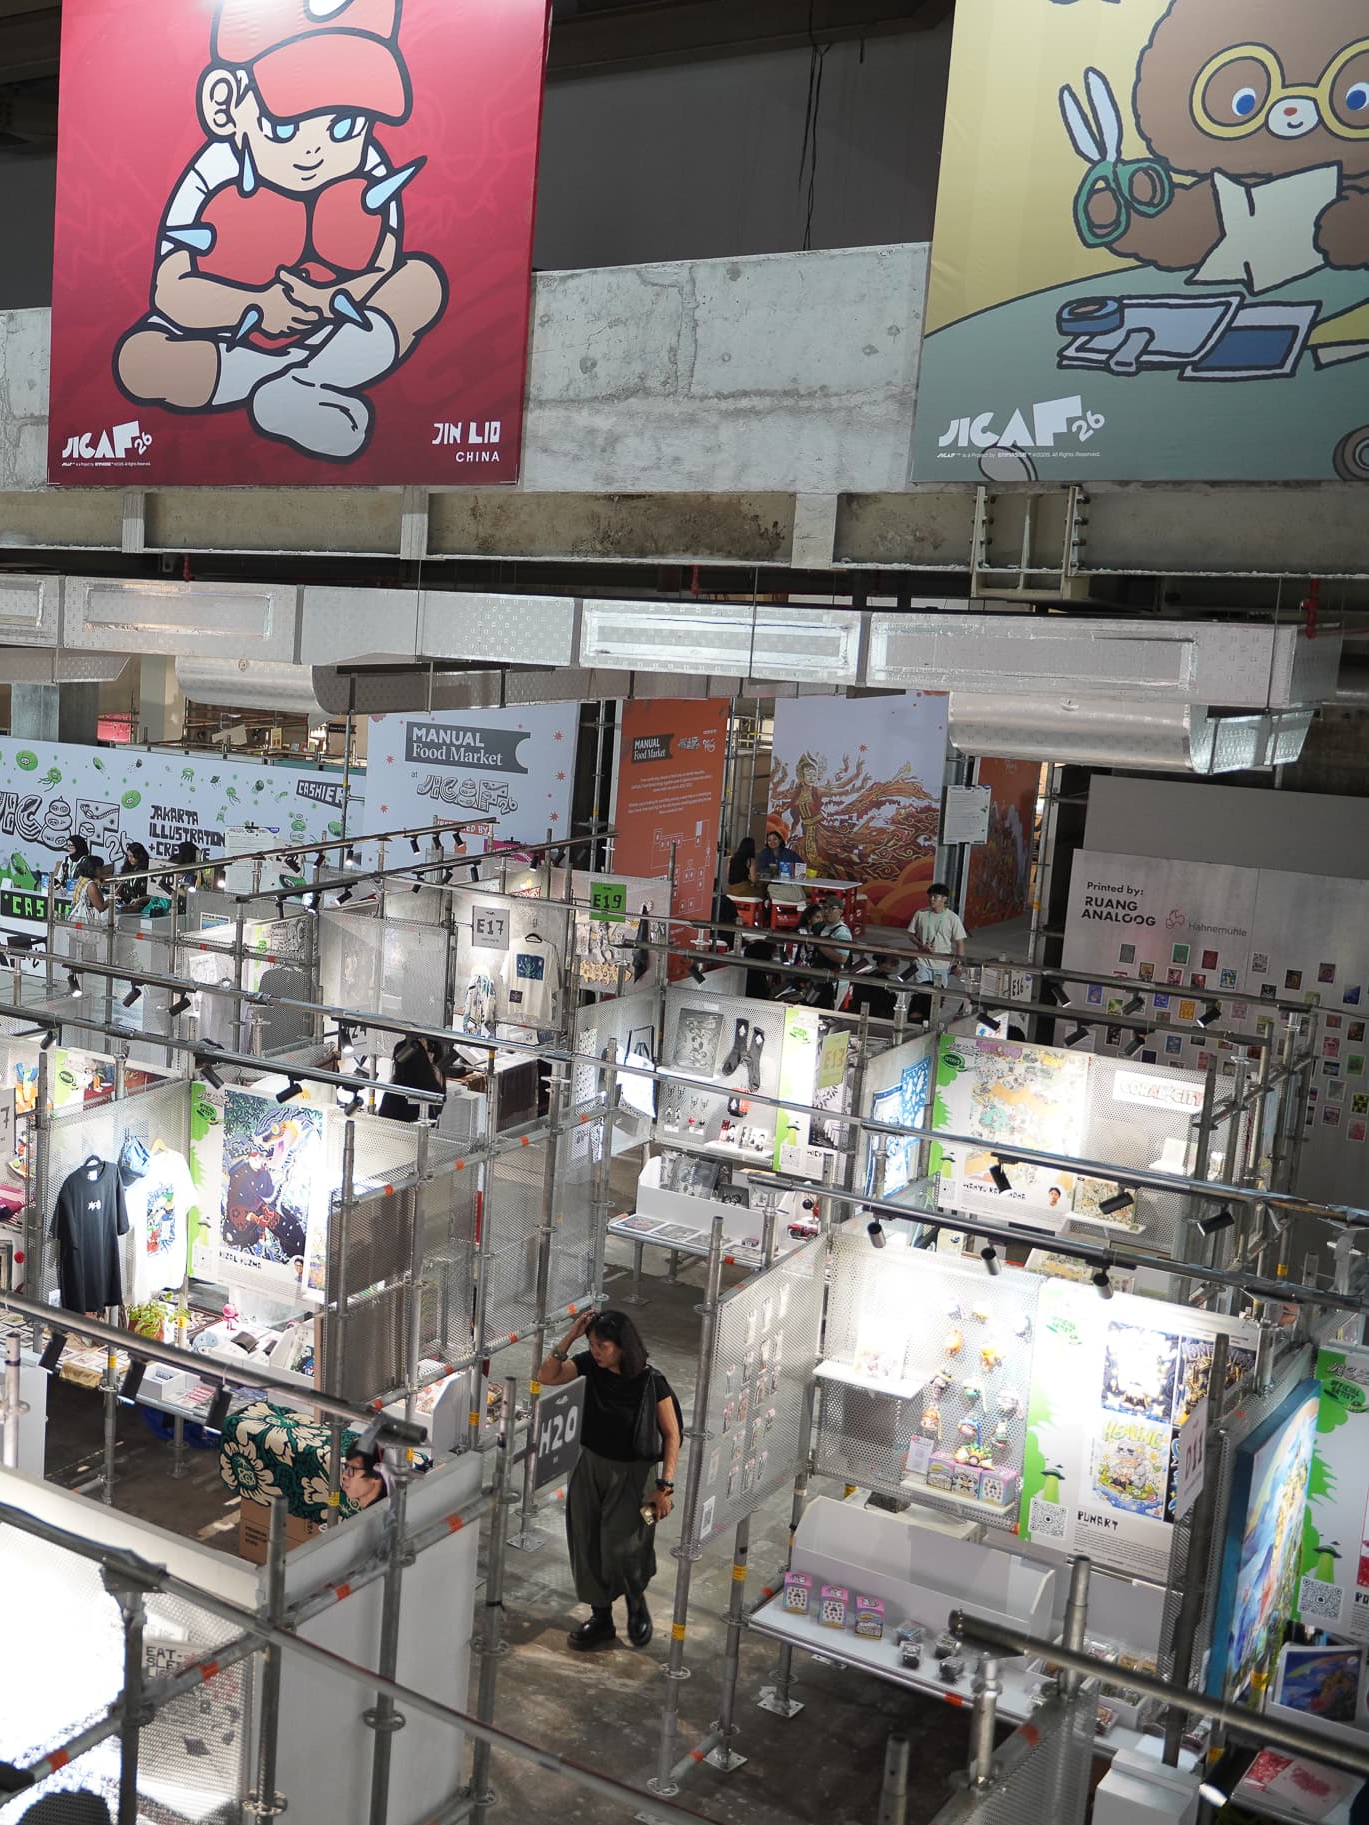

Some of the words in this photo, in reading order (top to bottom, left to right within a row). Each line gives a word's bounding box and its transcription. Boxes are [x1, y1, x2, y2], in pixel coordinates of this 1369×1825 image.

[432, 422, 462, 445] JIN
[455, 451, 500, 463] CHINA
[412, 726, 485, 747] MANUAL
[634, 737, 660, 750] MANUAL
[412, 742, 446, 761] Food
[450, 746, 503, 766] Market
[633, 749, 648, 761] Food
[648, 748, 667, 759] Market
[298, 781, 344, 804] CASHIER
[150, 804, 199, 825] JAKARTA
[149, 821, 226, 848] ILLUSTRATION
[1087, 881, 1124, 894] Printed
[1127, 886, 1144, 896] by:
[593, 894, 622, 908] E19
[1085, 896, 1138, 911] RUANG
[1081, 909, 1157, 926] ANALOOG
[477, 918, 504, 935] E17
